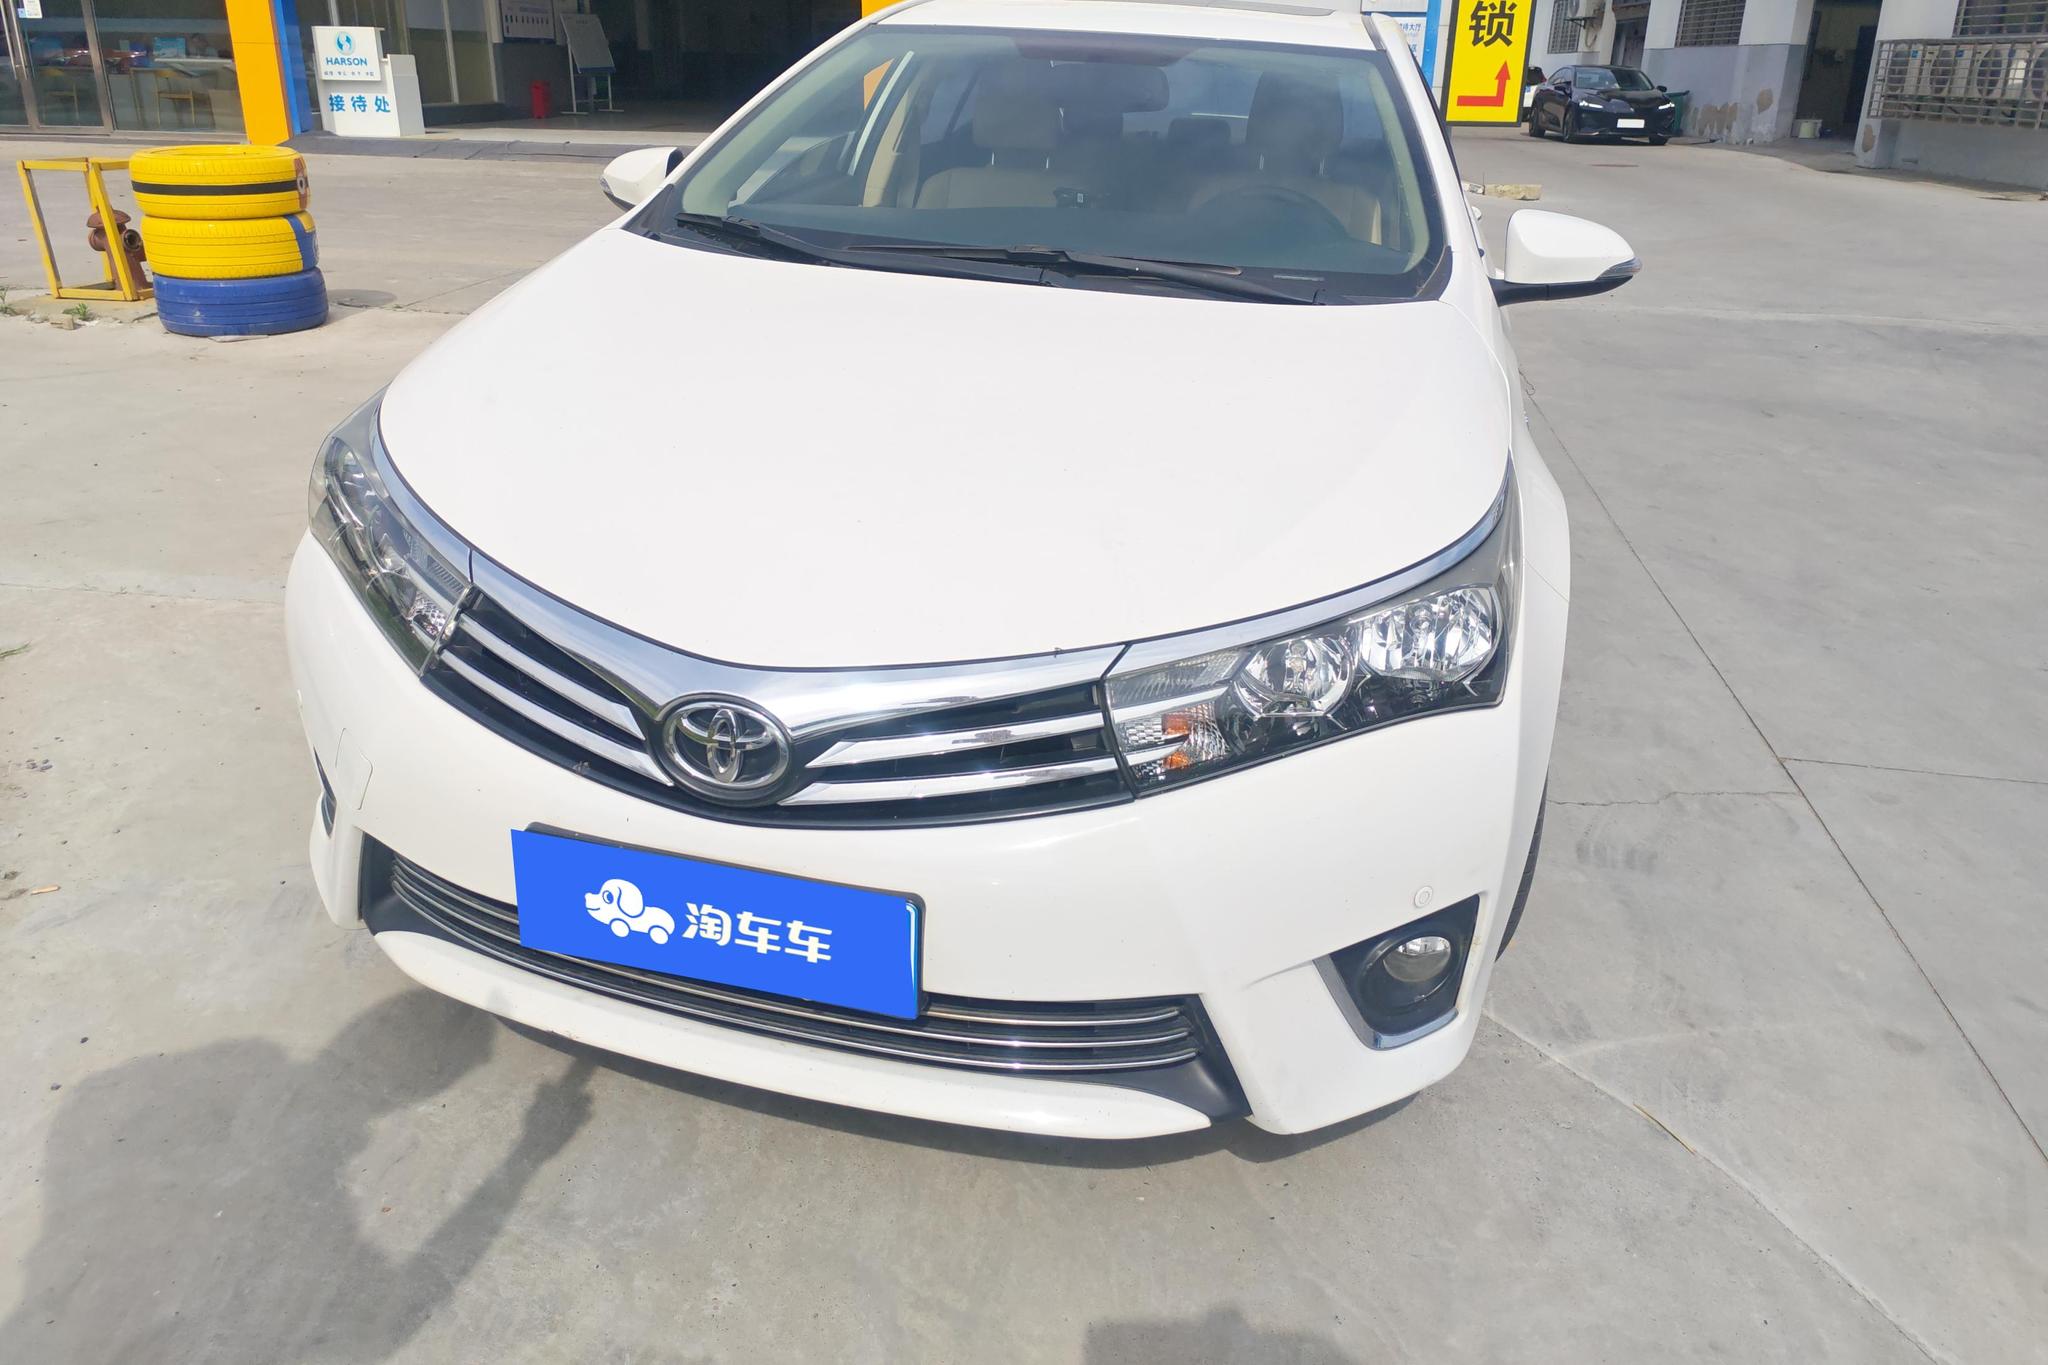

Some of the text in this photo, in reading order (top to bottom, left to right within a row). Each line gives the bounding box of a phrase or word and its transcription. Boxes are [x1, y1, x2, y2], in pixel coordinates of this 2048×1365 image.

[1399, 22, 1422, 32] 待大厅
[1469, 0, 1518, 47] 锁
[325, 57, 368, 66] HARSON
[328, 94, 391, 113] 接待处
